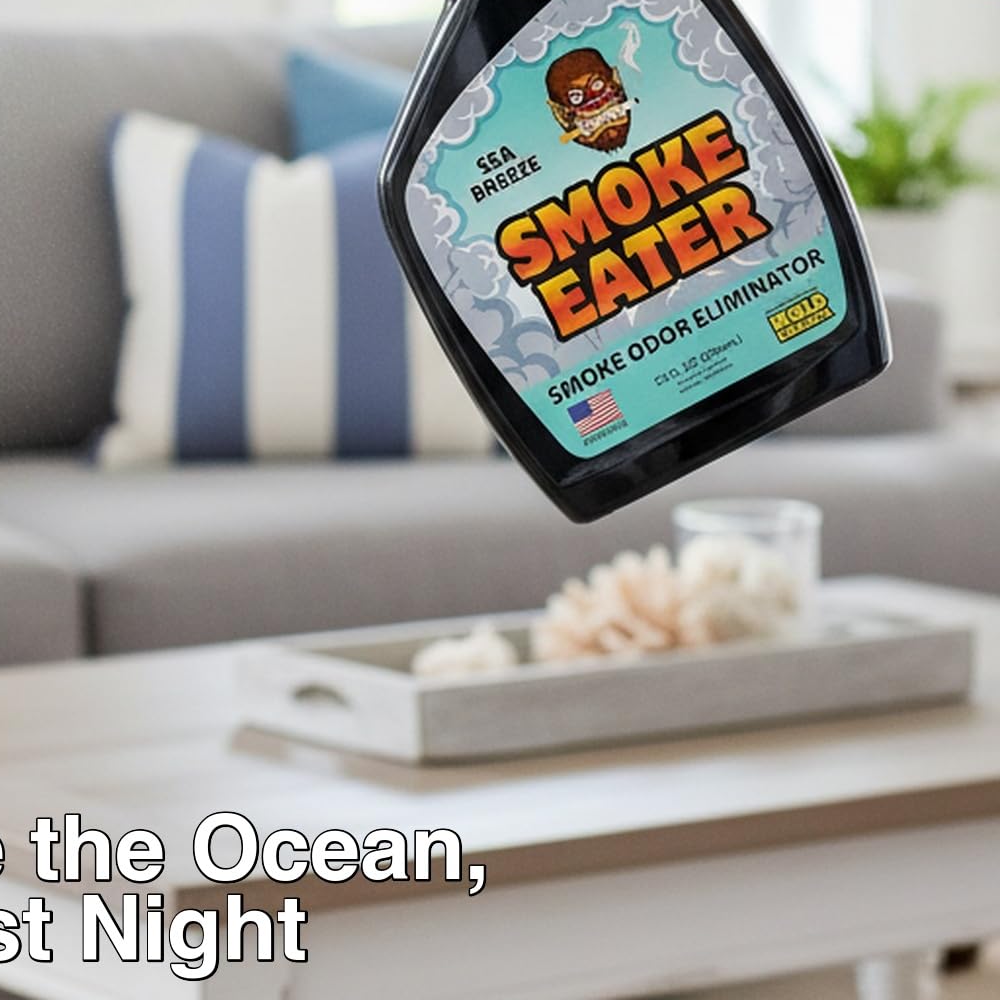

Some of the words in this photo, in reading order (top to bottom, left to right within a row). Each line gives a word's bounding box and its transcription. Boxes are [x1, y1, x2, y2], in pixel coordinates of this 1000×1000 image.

[495, 110, 748, 279] SMOKE
[533, 187, 772, 341] EATER
[548, 352, 627, 405] SMOKE
[628, 318, 693, 361] ODOR
[692, 249, 825, 328] ELIMINATOR
